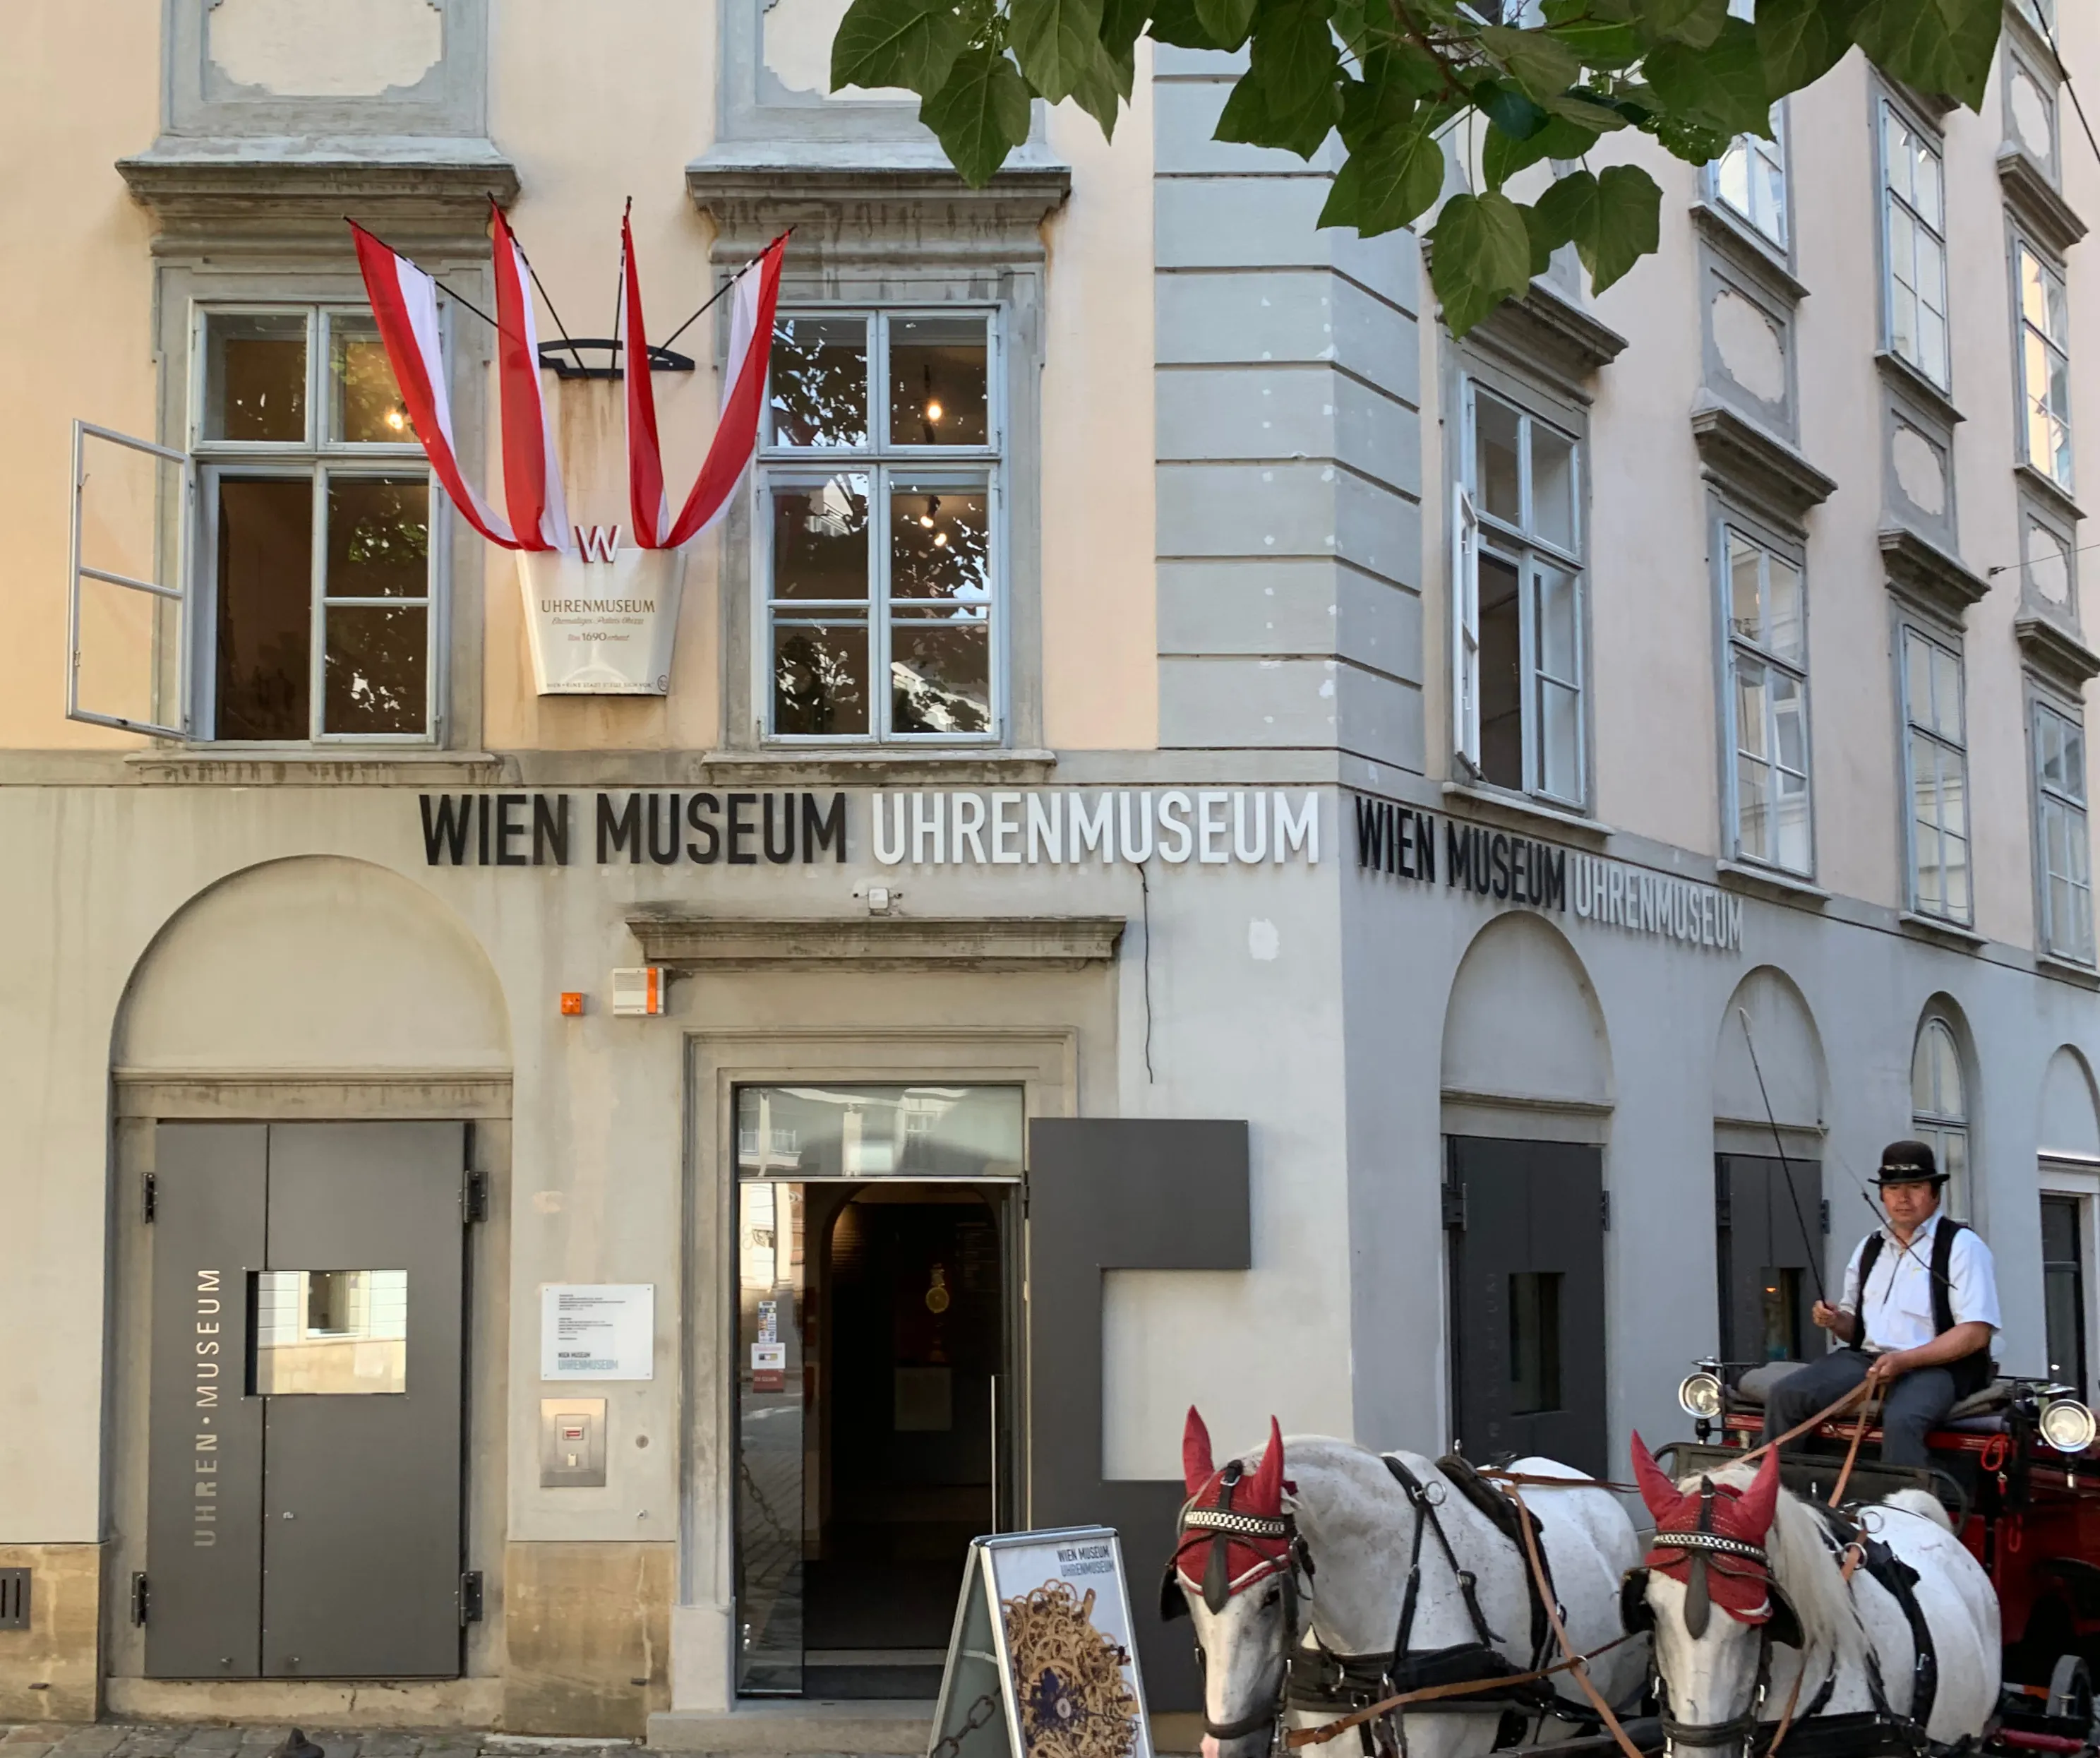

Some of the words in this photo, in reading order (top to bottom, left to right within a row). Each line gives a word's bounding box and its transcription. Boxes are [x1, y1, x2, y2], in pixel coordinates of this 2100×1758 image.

[541, 599, 656, 613] UHRENMUSEUM
[582, 632, 607, 642] 1690
[419, 794, 568, 866] WIEN
[596, 792, 846, 864] MUSEUM
[872, 791, 1319, 865] UHRENMUSEUM
[1355, 795, 1436, 883] WIEN
[1446, 820, 1566, 912] MUSEUM
[1573, 854, 1744, 952] UHRENMUSEUM
[1057, 1549, 1077, 1562] WIEN
[1078, 1545, 1110, 1560] MUSEUM
